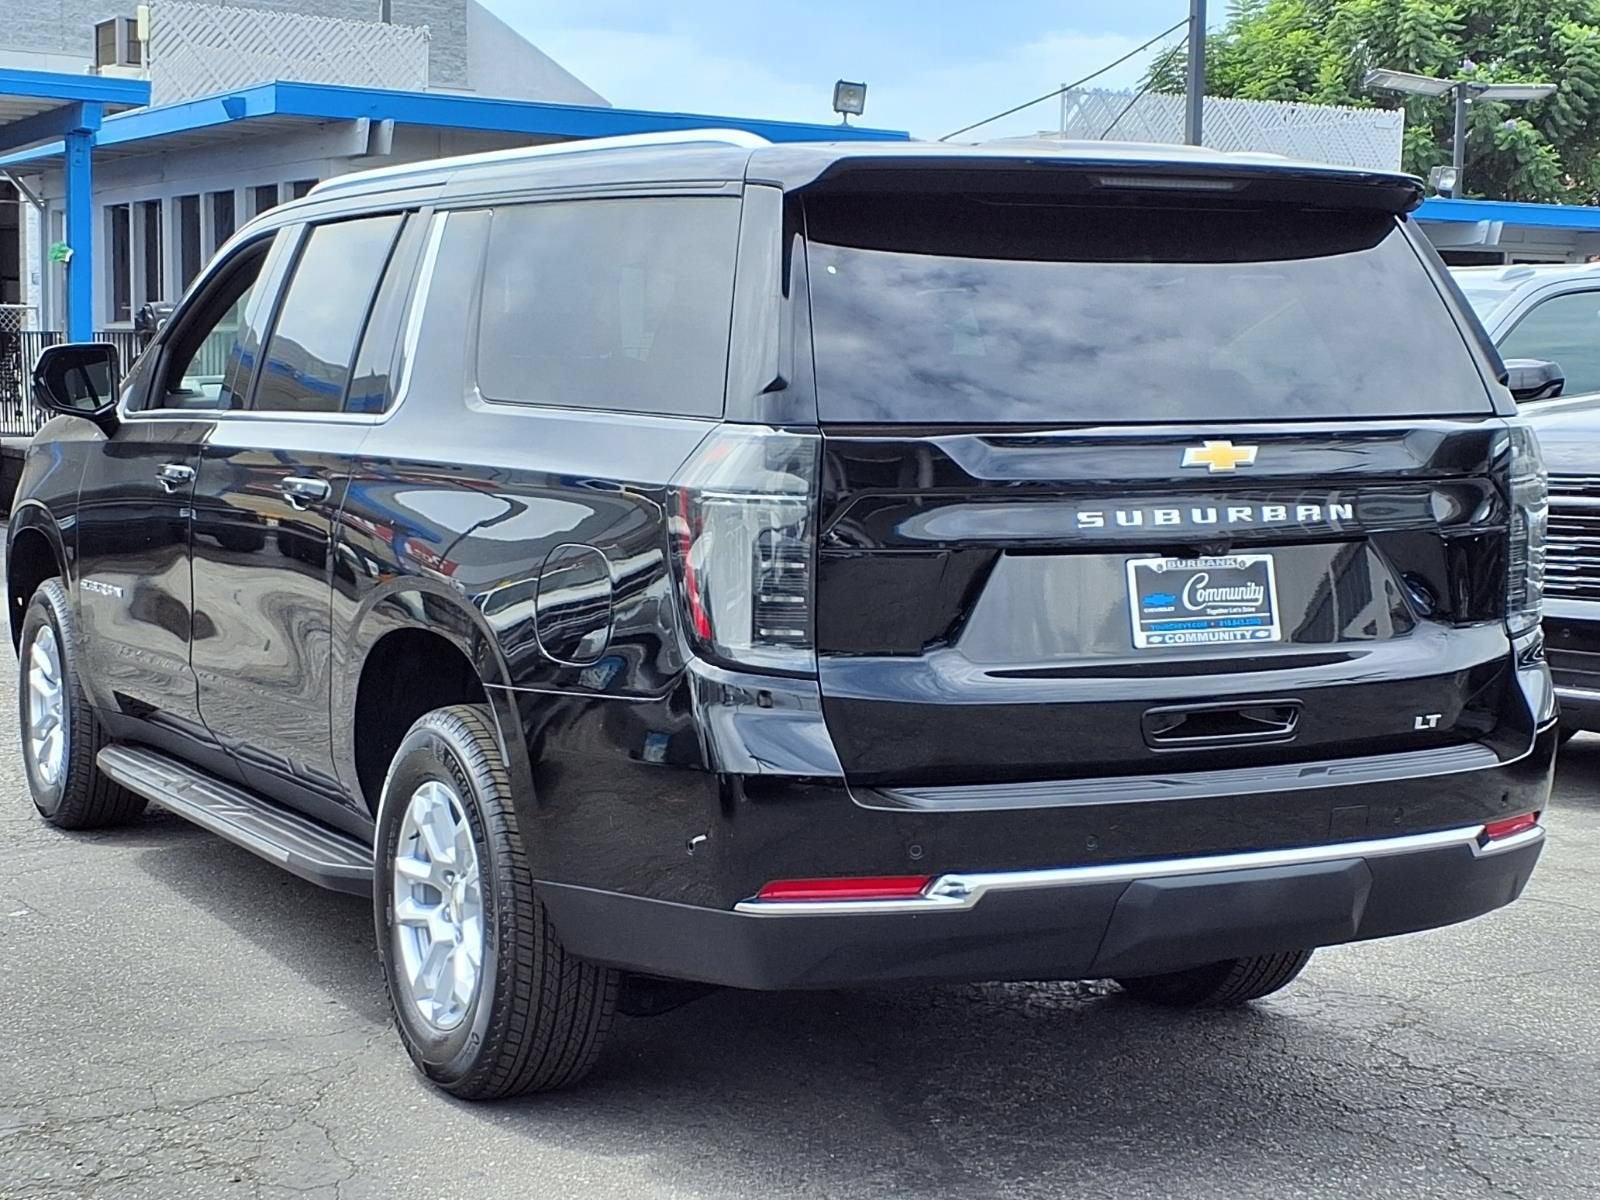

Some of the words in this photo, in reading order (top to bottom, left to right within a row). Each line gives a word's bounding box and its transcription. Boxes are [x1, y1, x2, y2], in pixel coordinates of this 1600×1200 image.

[1077, 503, 1353, 529] SUBURBAN
[1166, 558, 1237, 569] BURBANK
[1182, 572, 1264, 611] Community
[1165, 630, 1252, 644] COMMUNITY
[1414, 713, 1442, 729] LT
